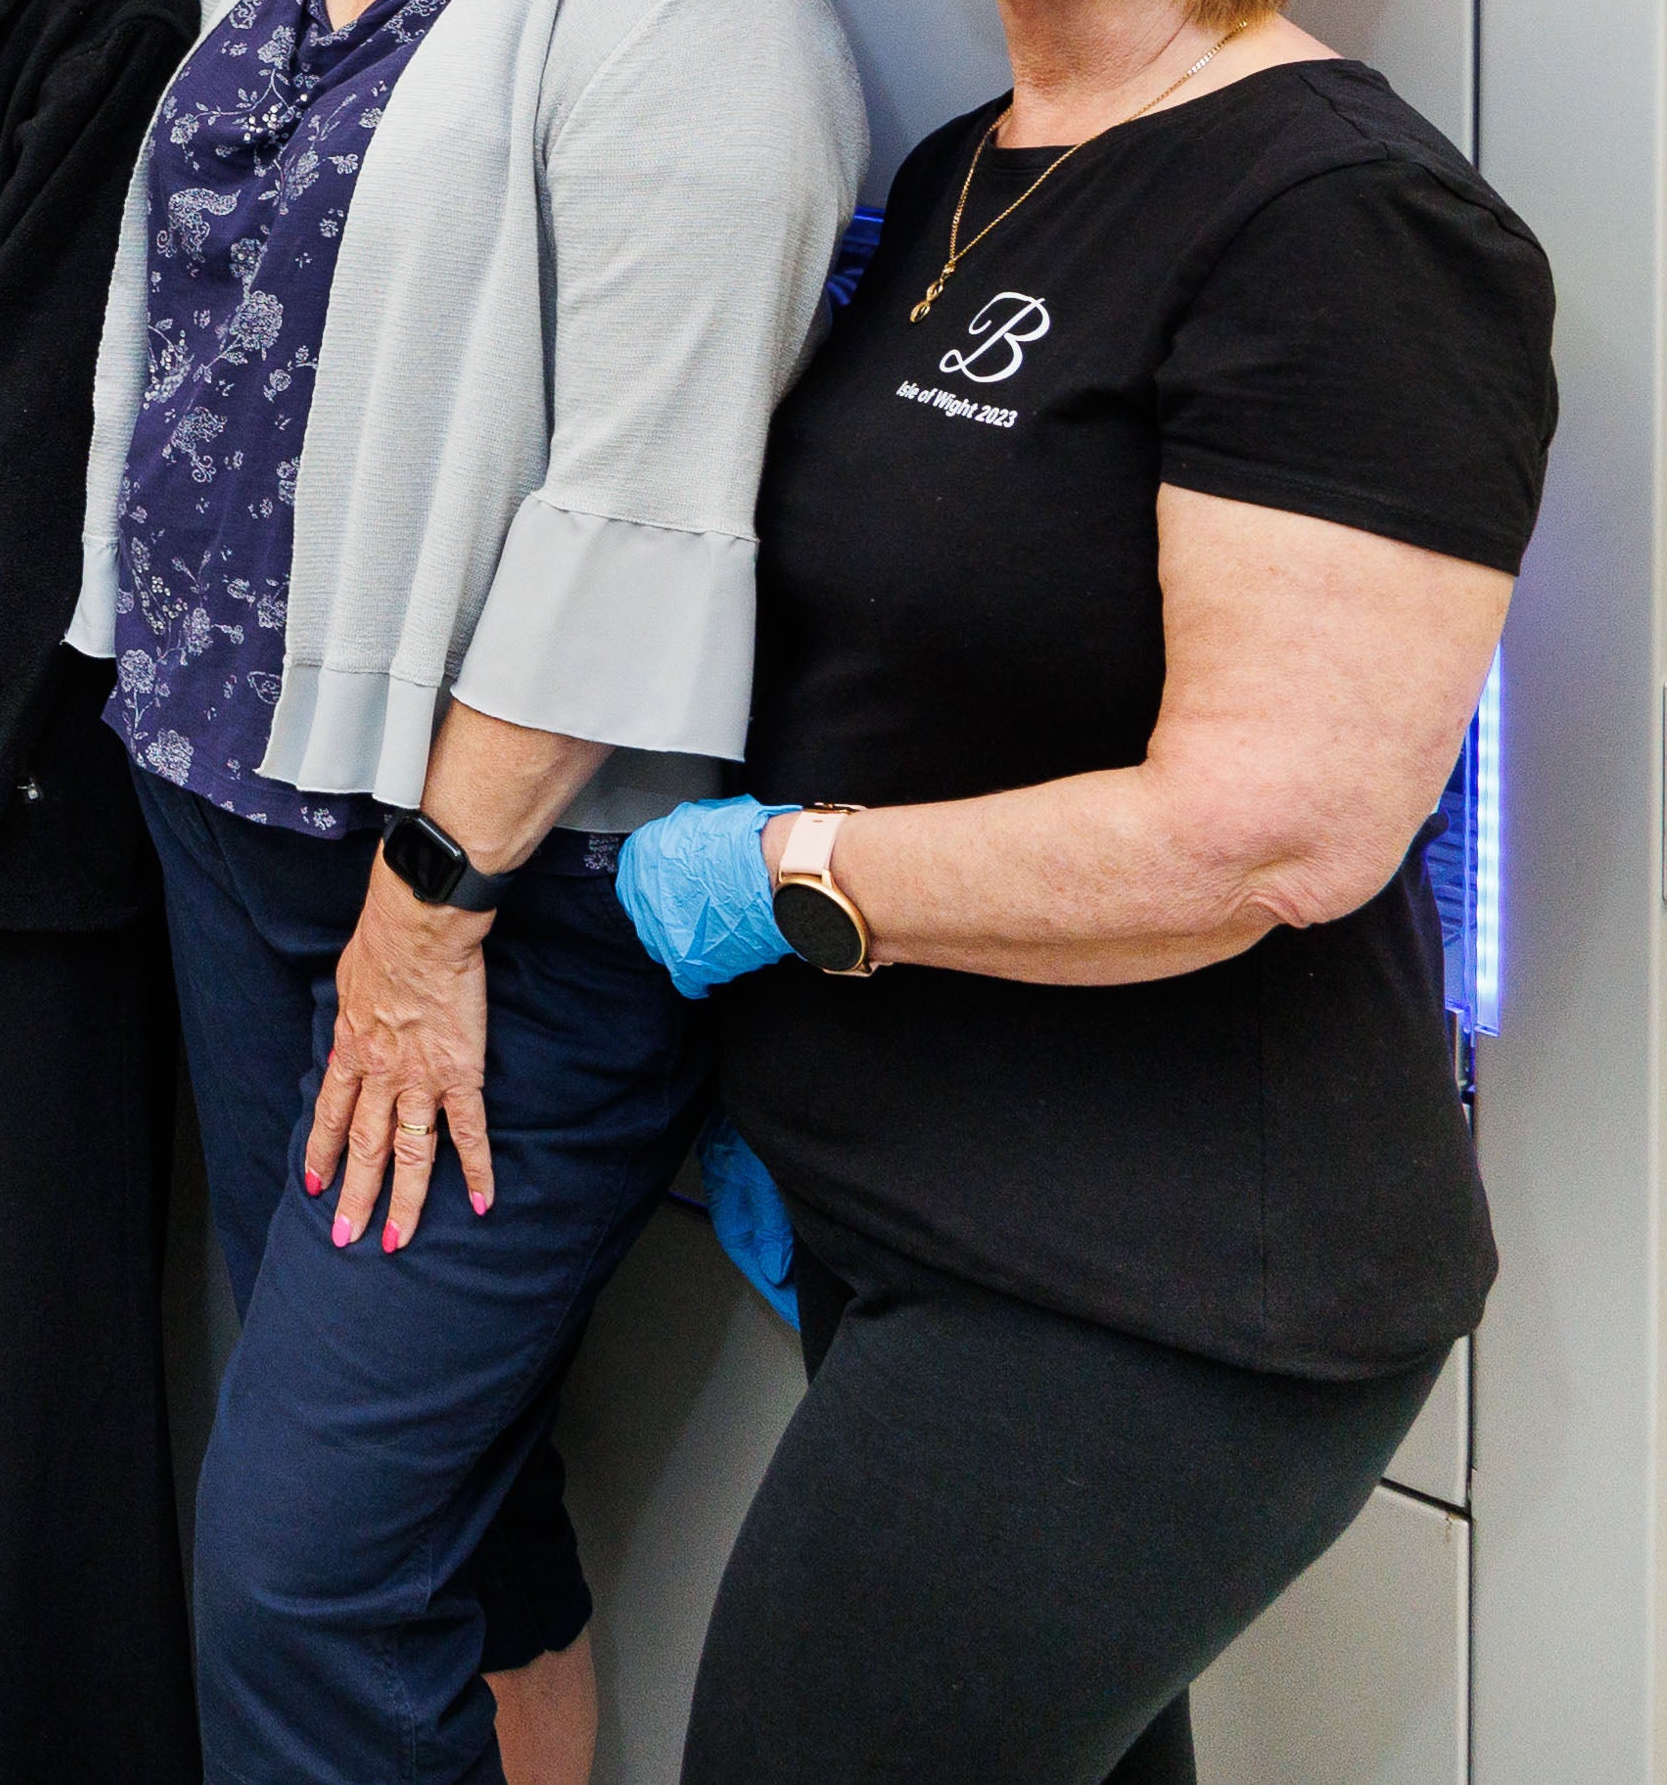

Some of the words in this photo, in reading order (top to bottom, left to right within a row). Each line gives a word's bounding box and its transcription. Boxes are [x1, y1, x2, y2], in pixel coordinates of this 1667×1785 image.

[939, 291, 1051, 383] B
[895, 380, 919, 400] Isle
[917, 387, 936, 404] of
[932, 390, 979, 418] Wight
[975, 405, 1018, 428] 2023
